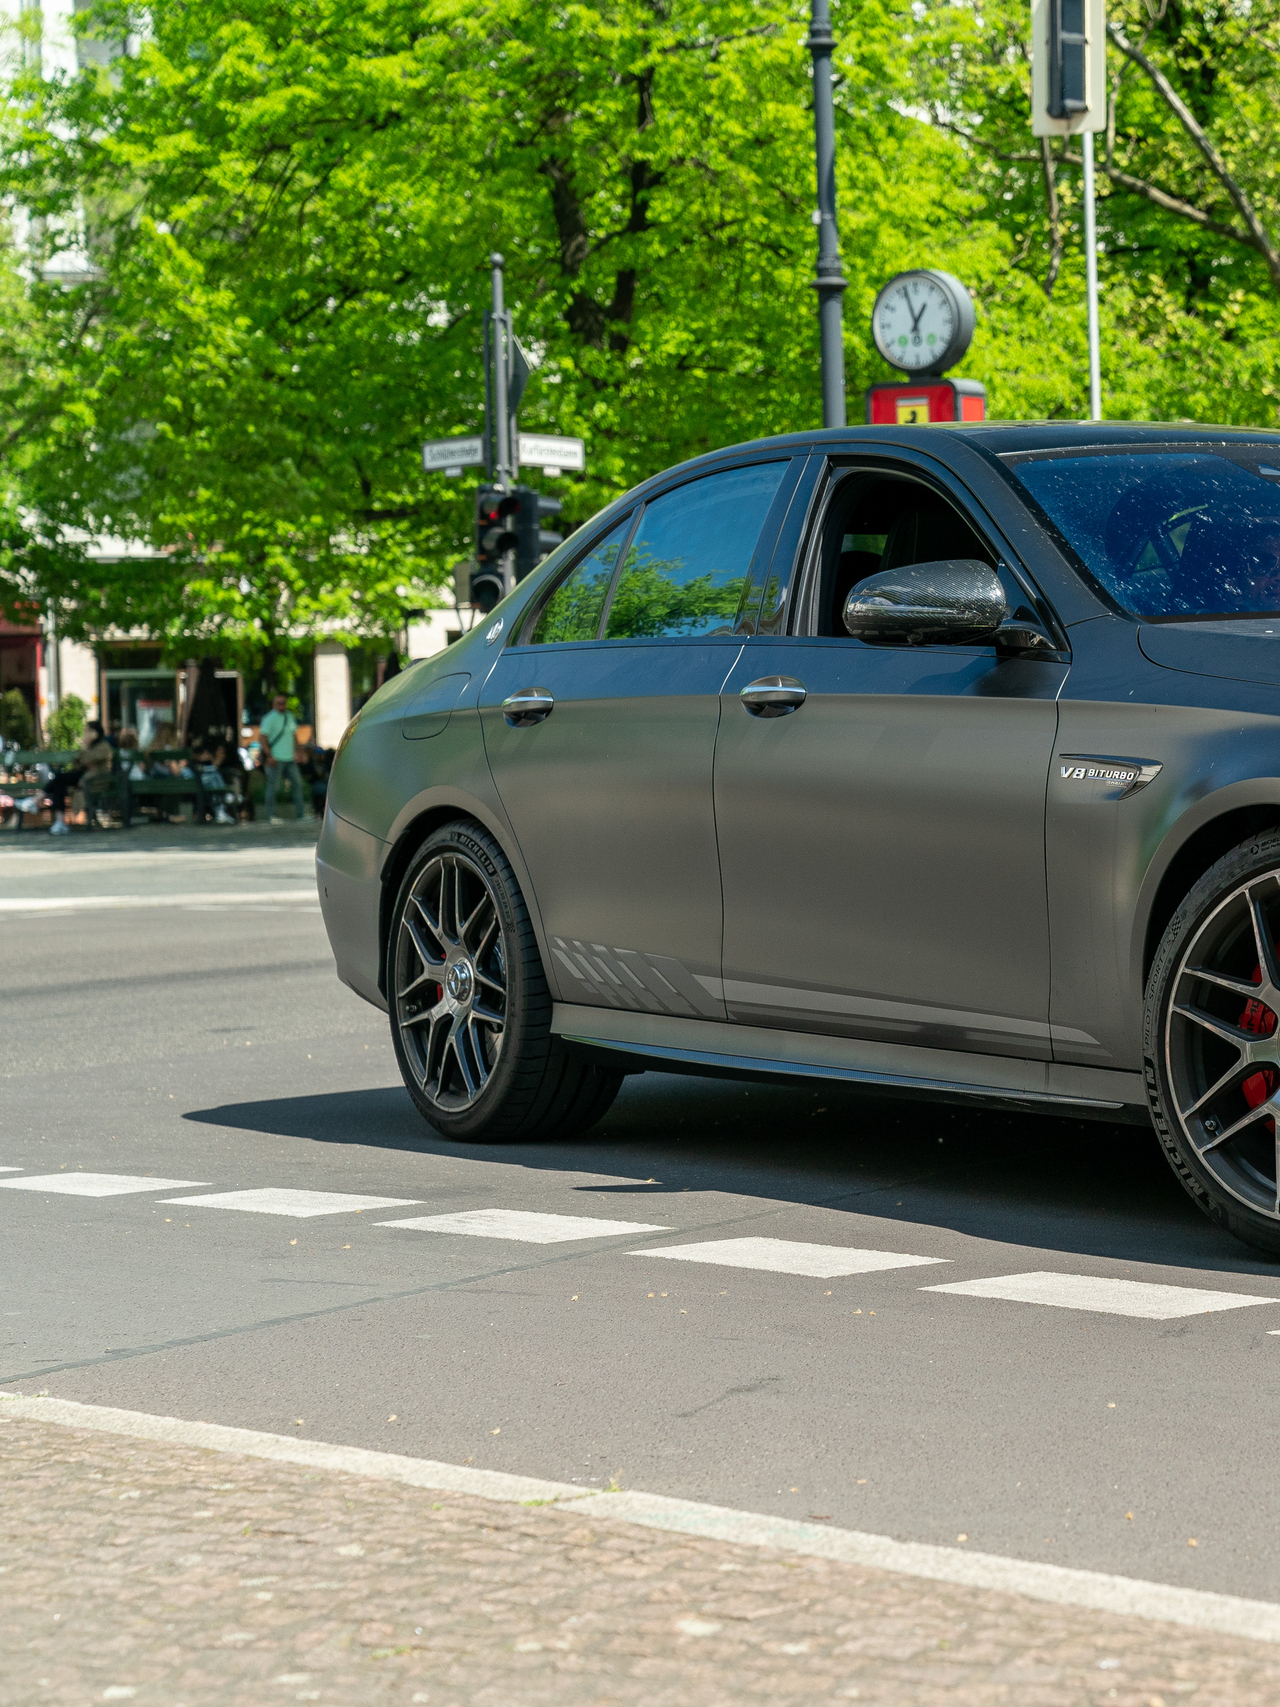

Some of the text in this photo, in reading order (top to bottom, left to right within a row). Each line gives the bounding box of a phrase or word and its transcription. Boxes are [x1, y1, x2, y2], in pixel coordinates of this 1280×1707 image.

[1060, 766, 1134, 780] V8 BITURBO
[459, 835, 495, 874] MICHELIN
[1149, 957, 1164, 1000] SPORT
[1145, 1066, 1205, 1197] MICHELIN
